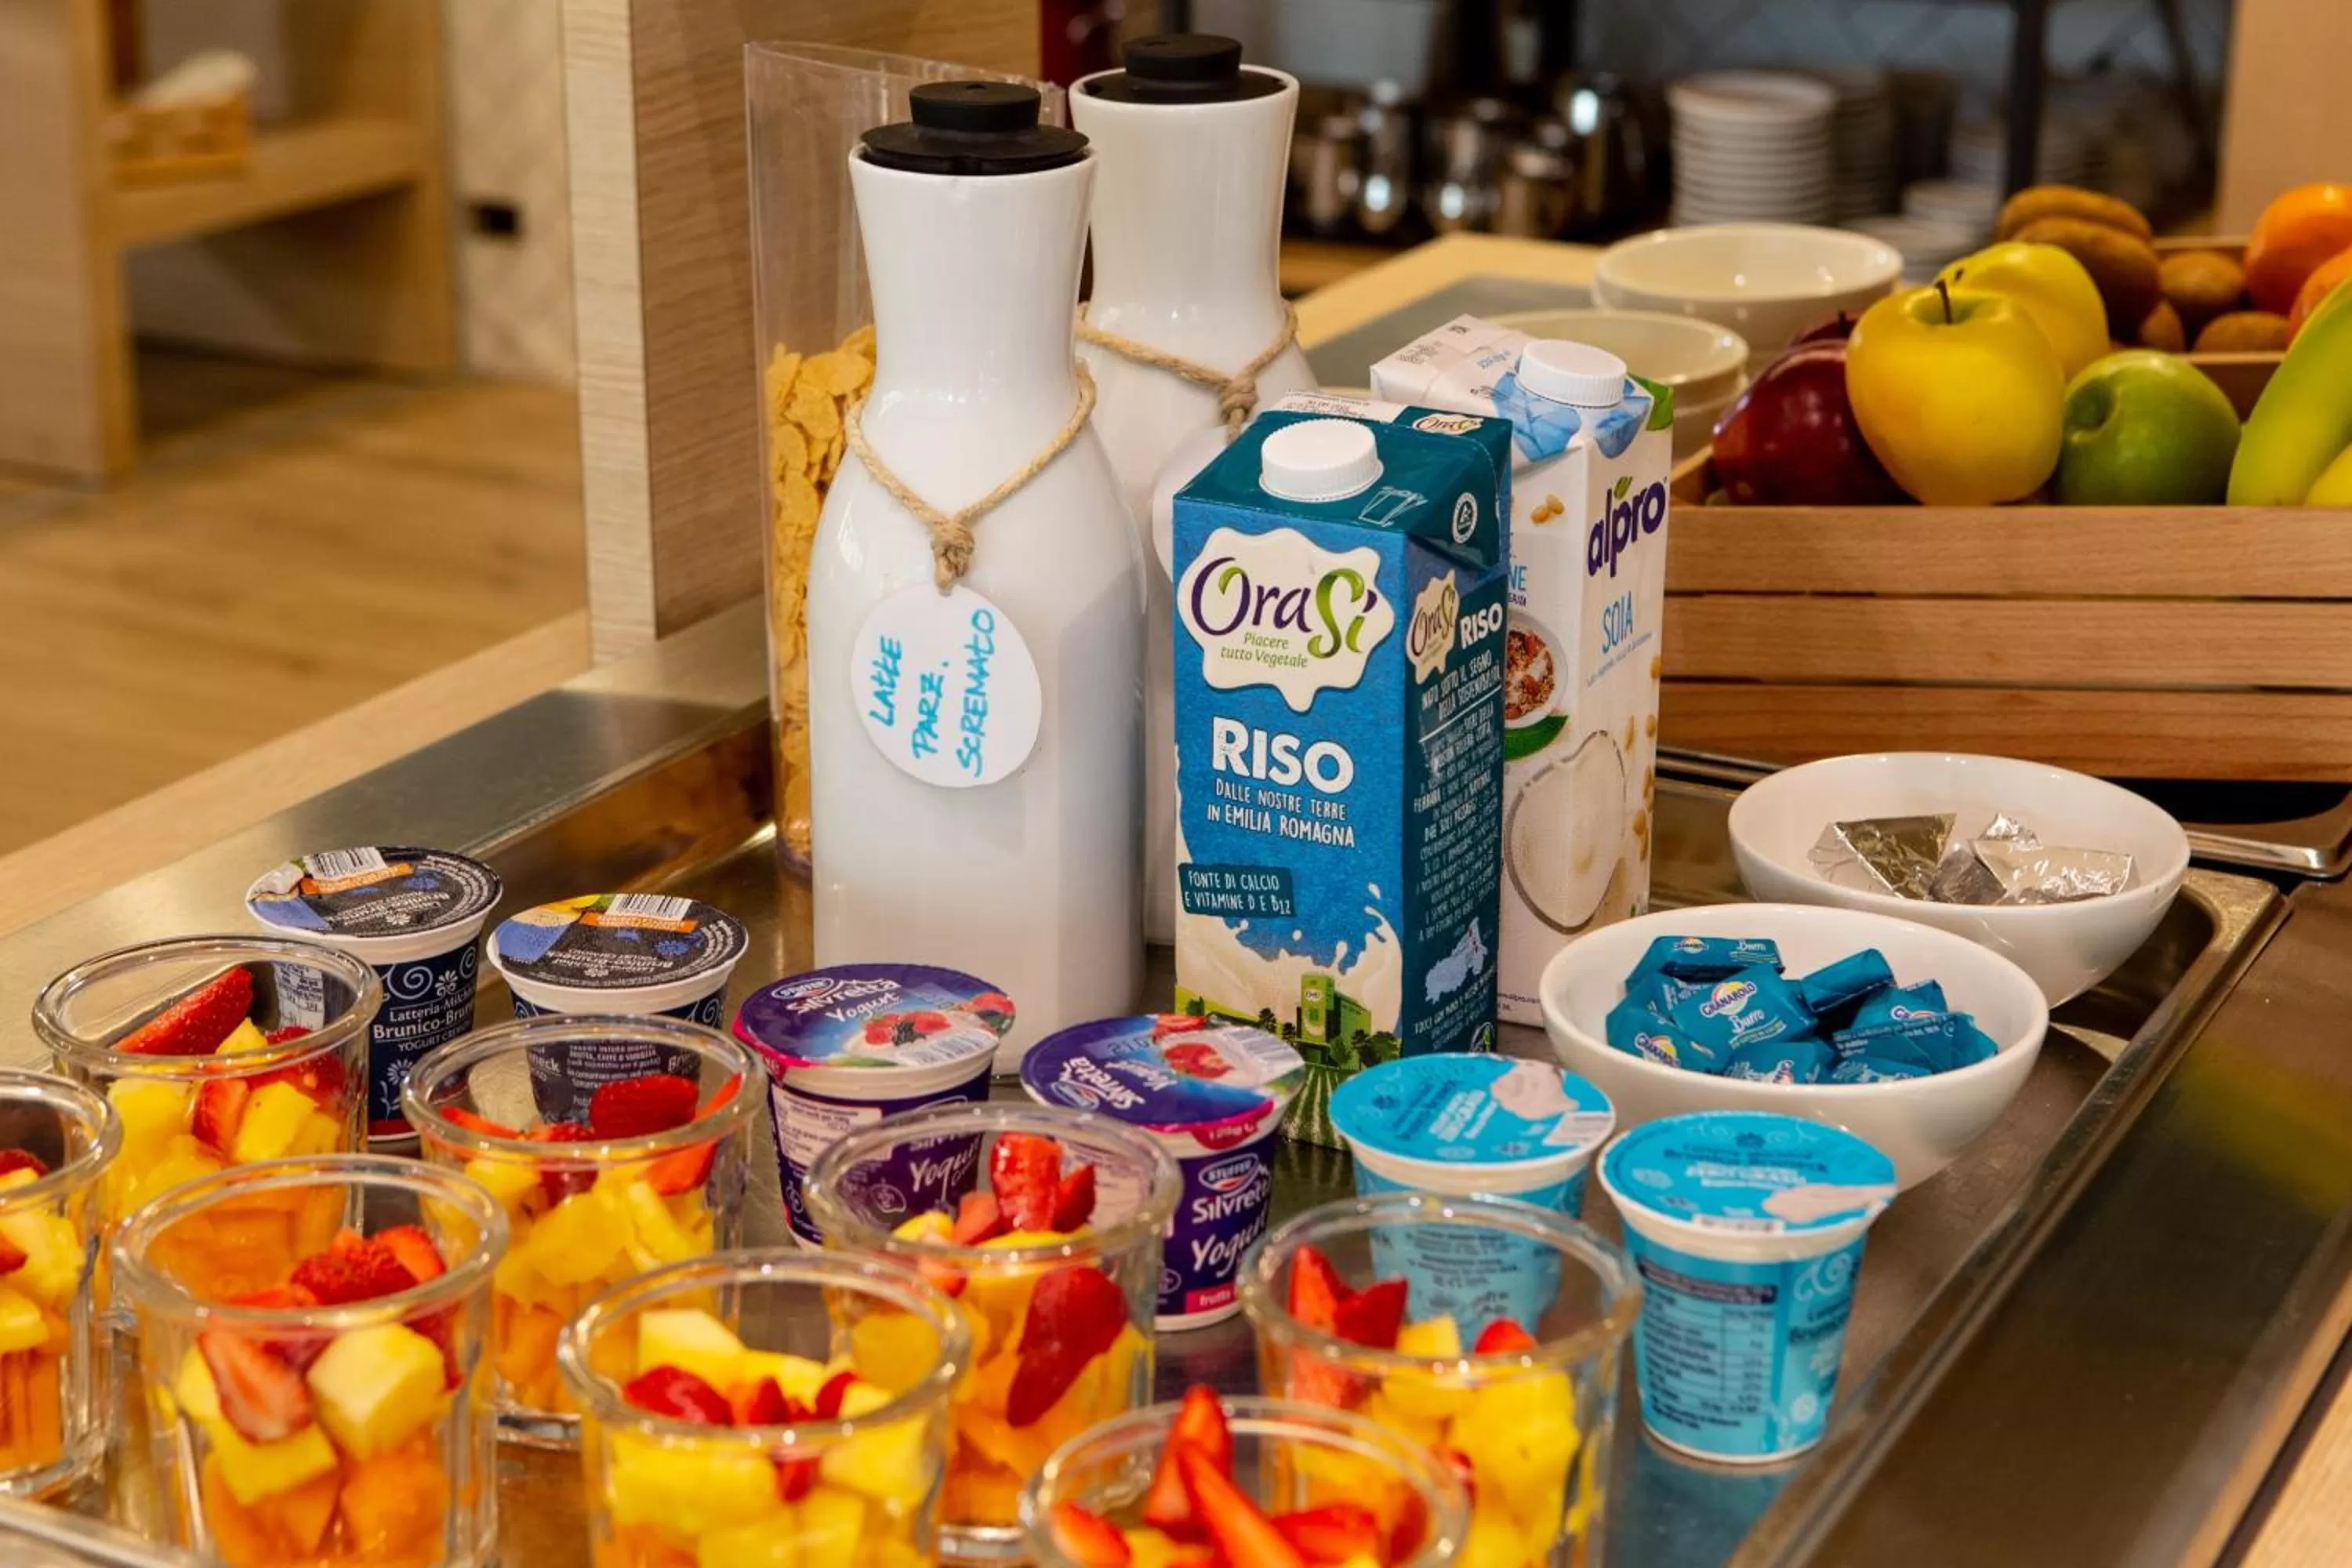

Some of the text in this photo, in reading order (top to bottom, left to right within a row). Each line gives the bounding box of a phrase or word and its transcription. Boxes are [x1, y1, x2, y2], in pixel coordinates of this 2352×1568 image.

[1588, 481, 1666, 578] alpro
[1243, 631, 1289, 650] Piacere
[1460, 602, 1503, 650] RISO
[1602, 590, 1633, 655] SOIA
[1220, 645, 1308, 669] tutto Vegetale
[911, 660, 950, 760] PARZ.
[1212, 716, 1355, 794] RISO
[1216, 778, 1347, 822] DALLE NOSTRE TERRE
[1207, 803, 1356, 849] IN EMILIA ROMAGNA
[1187, 869, 1280, 891] FONTE DI CALCIO
[1184, 891, 1292, 916] E VITAMINE D E B12
[786, 979, 902, 1015] Silvretta
[825, 992, 899, 1022] Yogurt
[1701, 982, 1756, 1017] GRANAROLO
